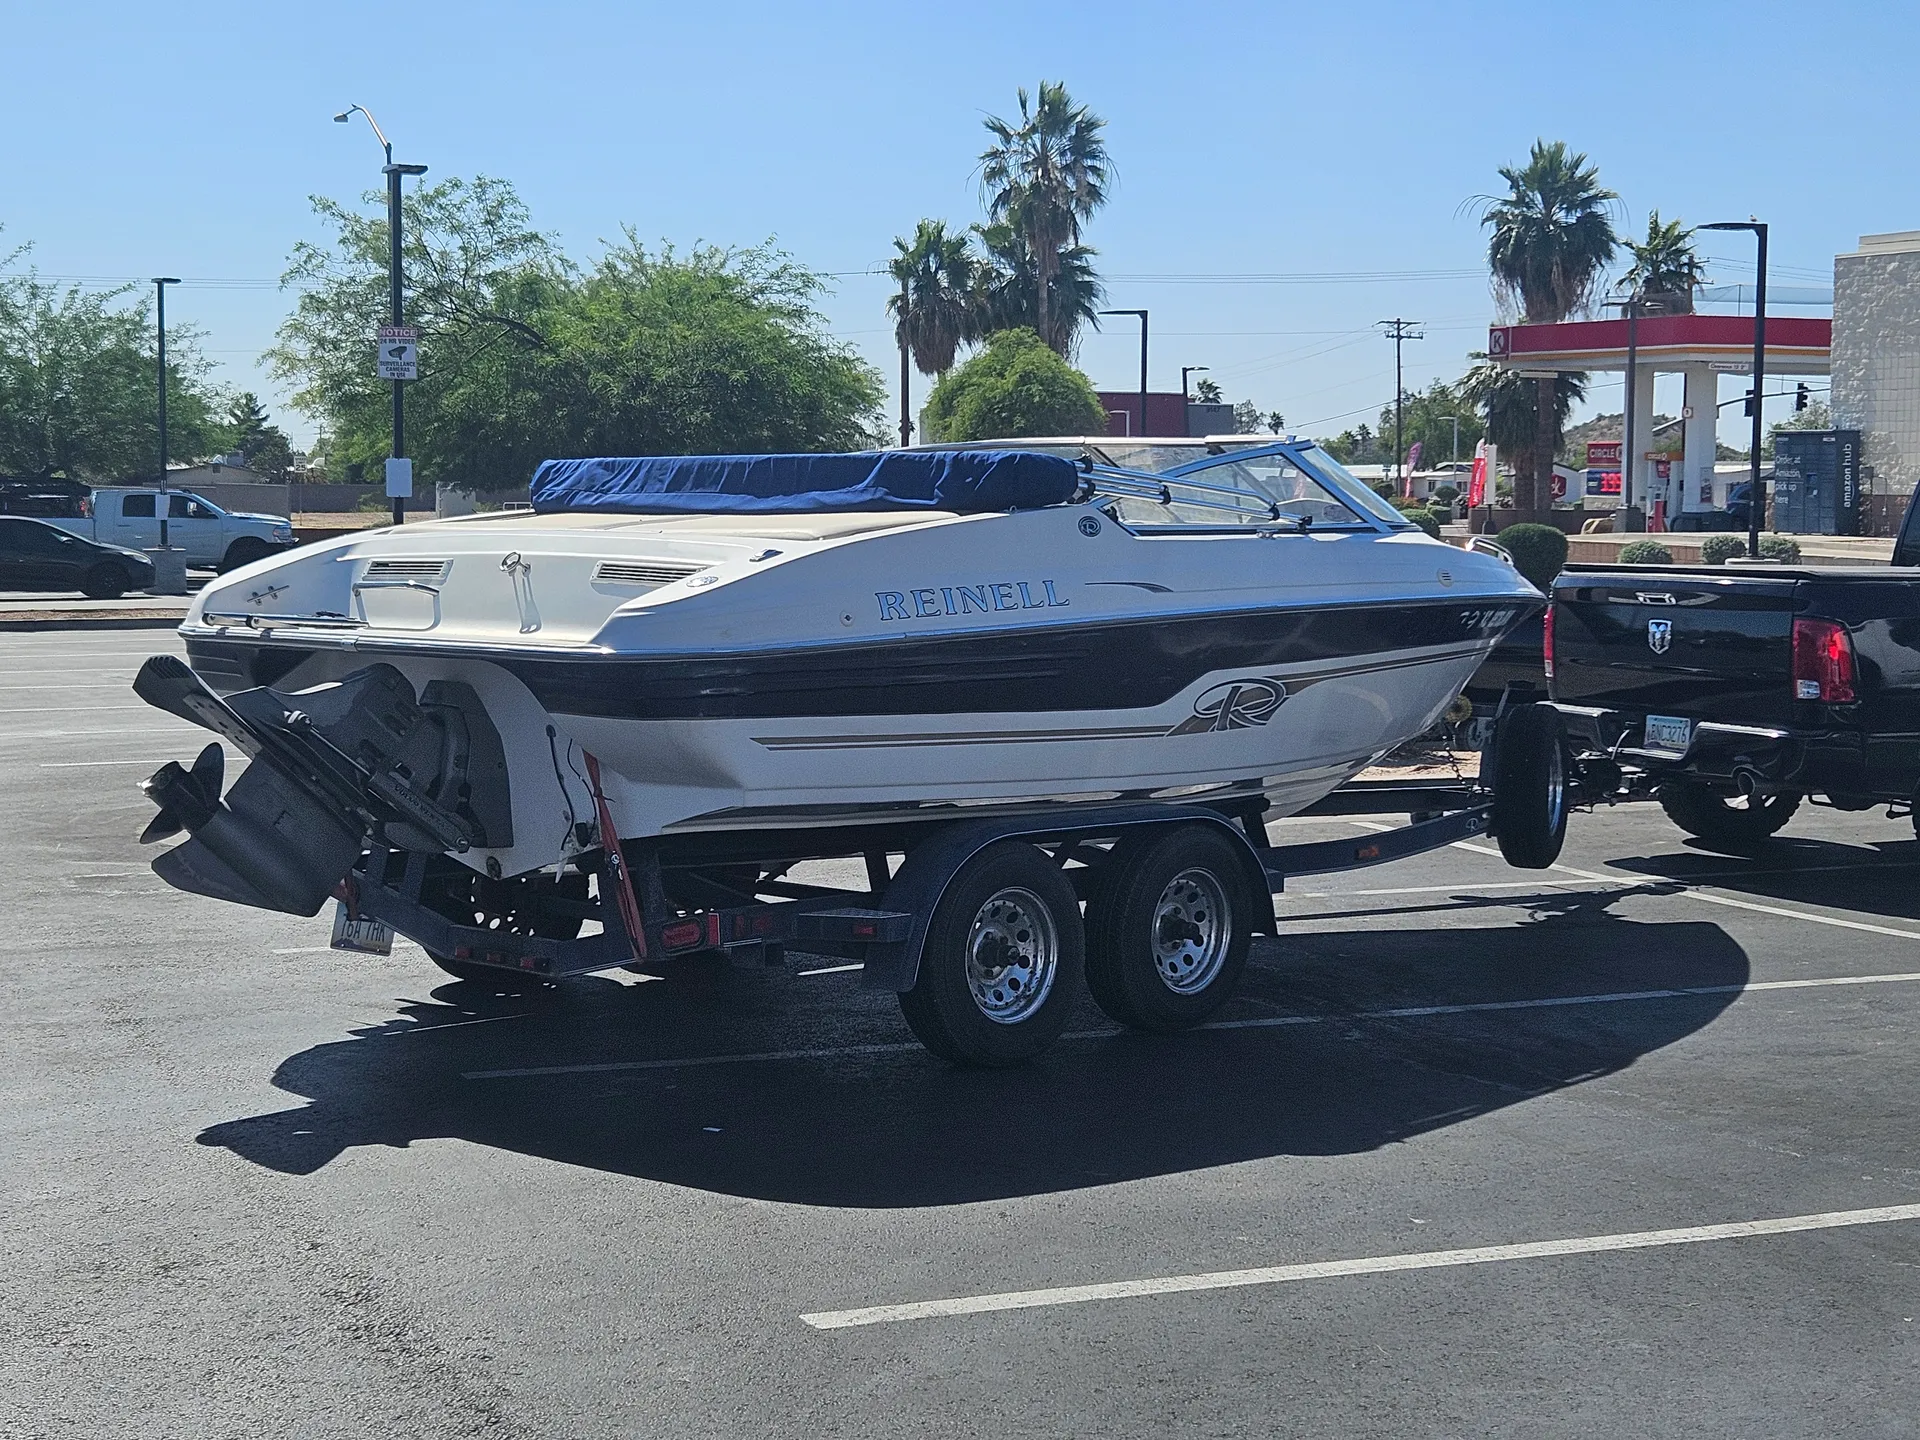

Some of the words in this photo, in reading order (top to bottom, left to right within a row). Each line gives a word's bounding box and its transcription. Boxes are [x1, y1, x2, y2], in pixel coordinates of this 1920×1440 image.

[379, 328, 416, 337] NOTICE
[1493, 335, 1502, 349] K
[1589, 448, 1615, 458] CIRCLE
[1842, 443, 1852, 466] hub
[296, 464, 306, 472] 25
[1843, 467, 1852, 508] amazon
[1775, 496, 1789, 504] here
[874, 579, 1070, 621] REINELL
